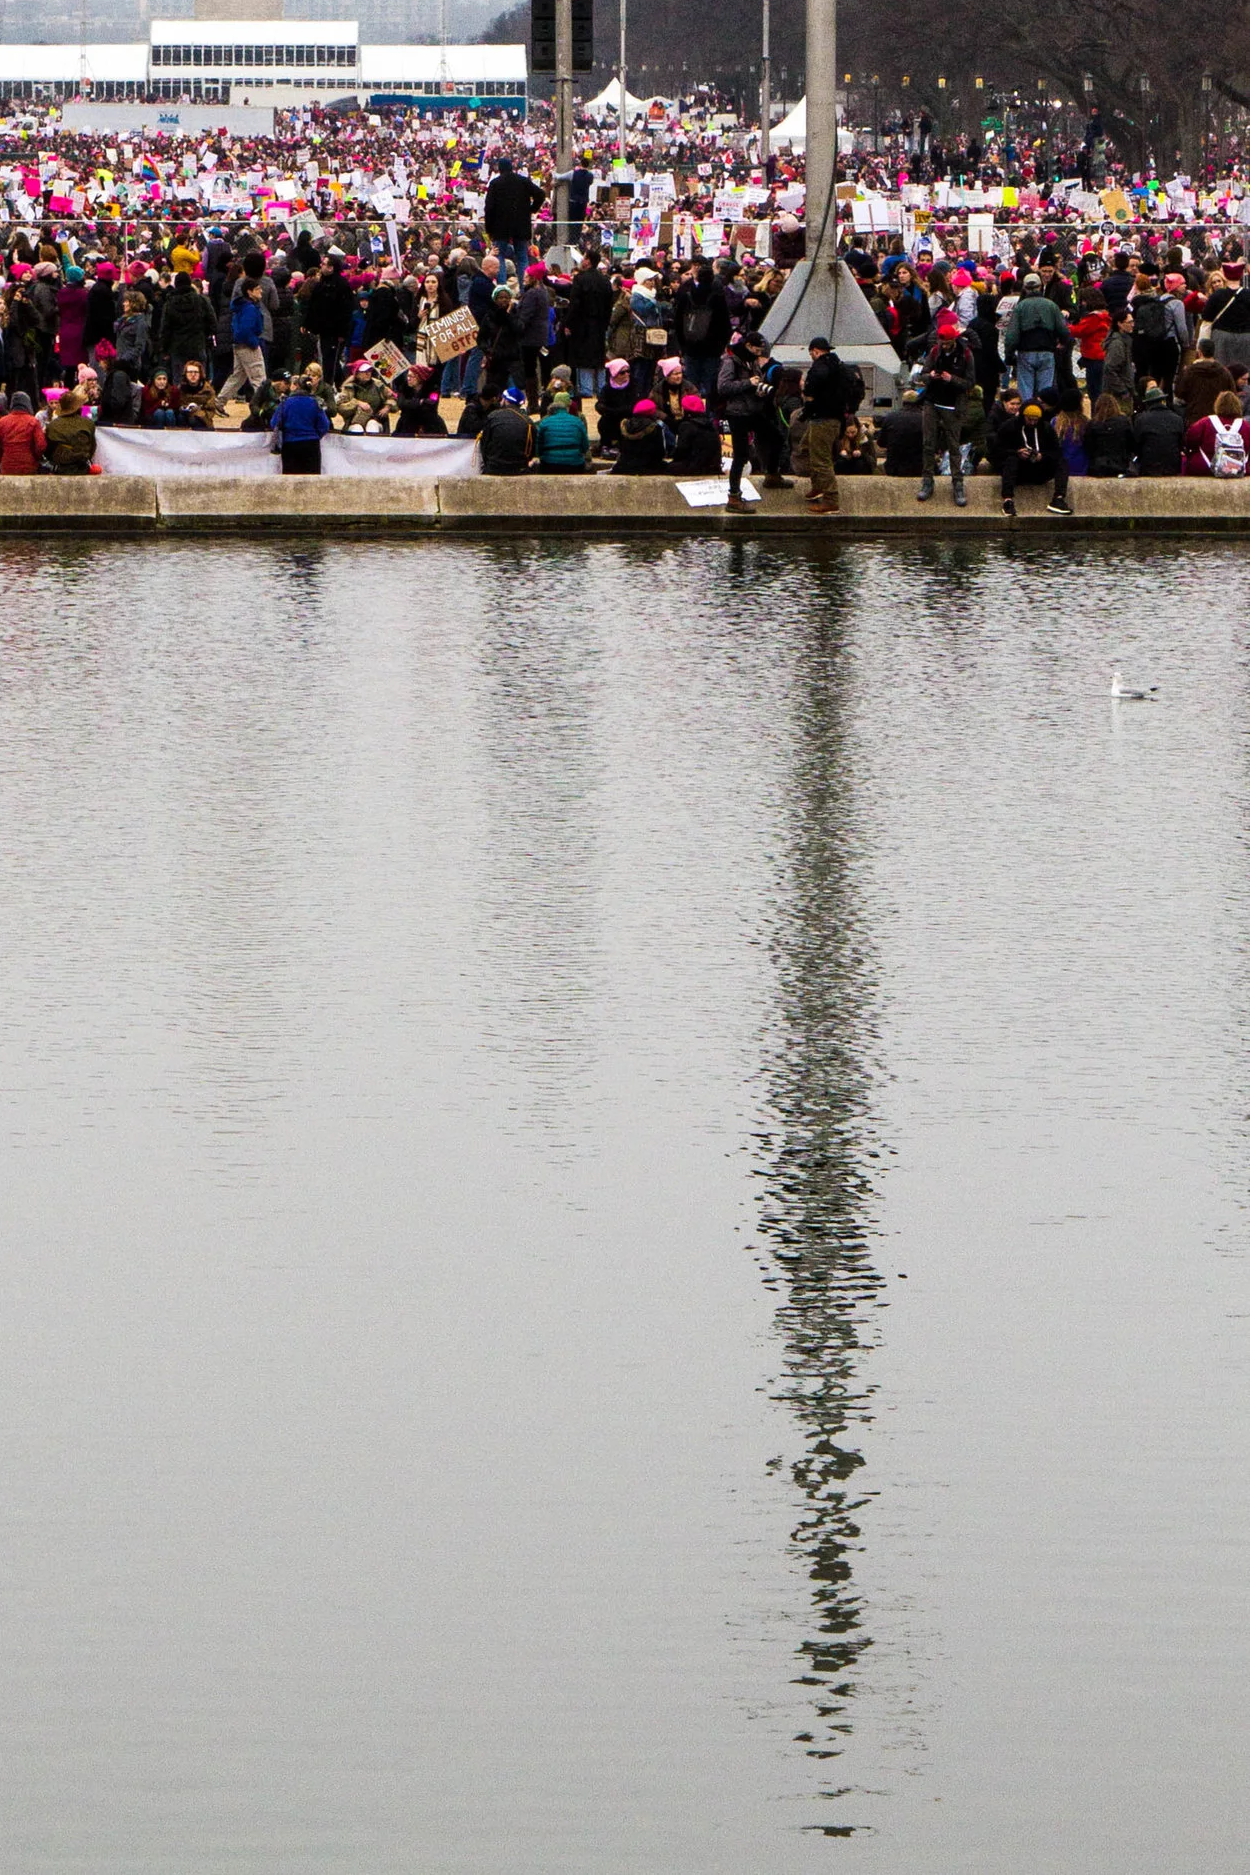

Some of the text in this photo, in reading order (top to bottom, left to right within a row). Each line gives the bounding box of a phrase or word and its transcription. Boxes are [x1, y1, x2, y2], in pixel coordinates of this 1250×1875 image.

[425, 306, 472, 336] FEMINISM
[430, 320, 477, 347] FOR ALL
